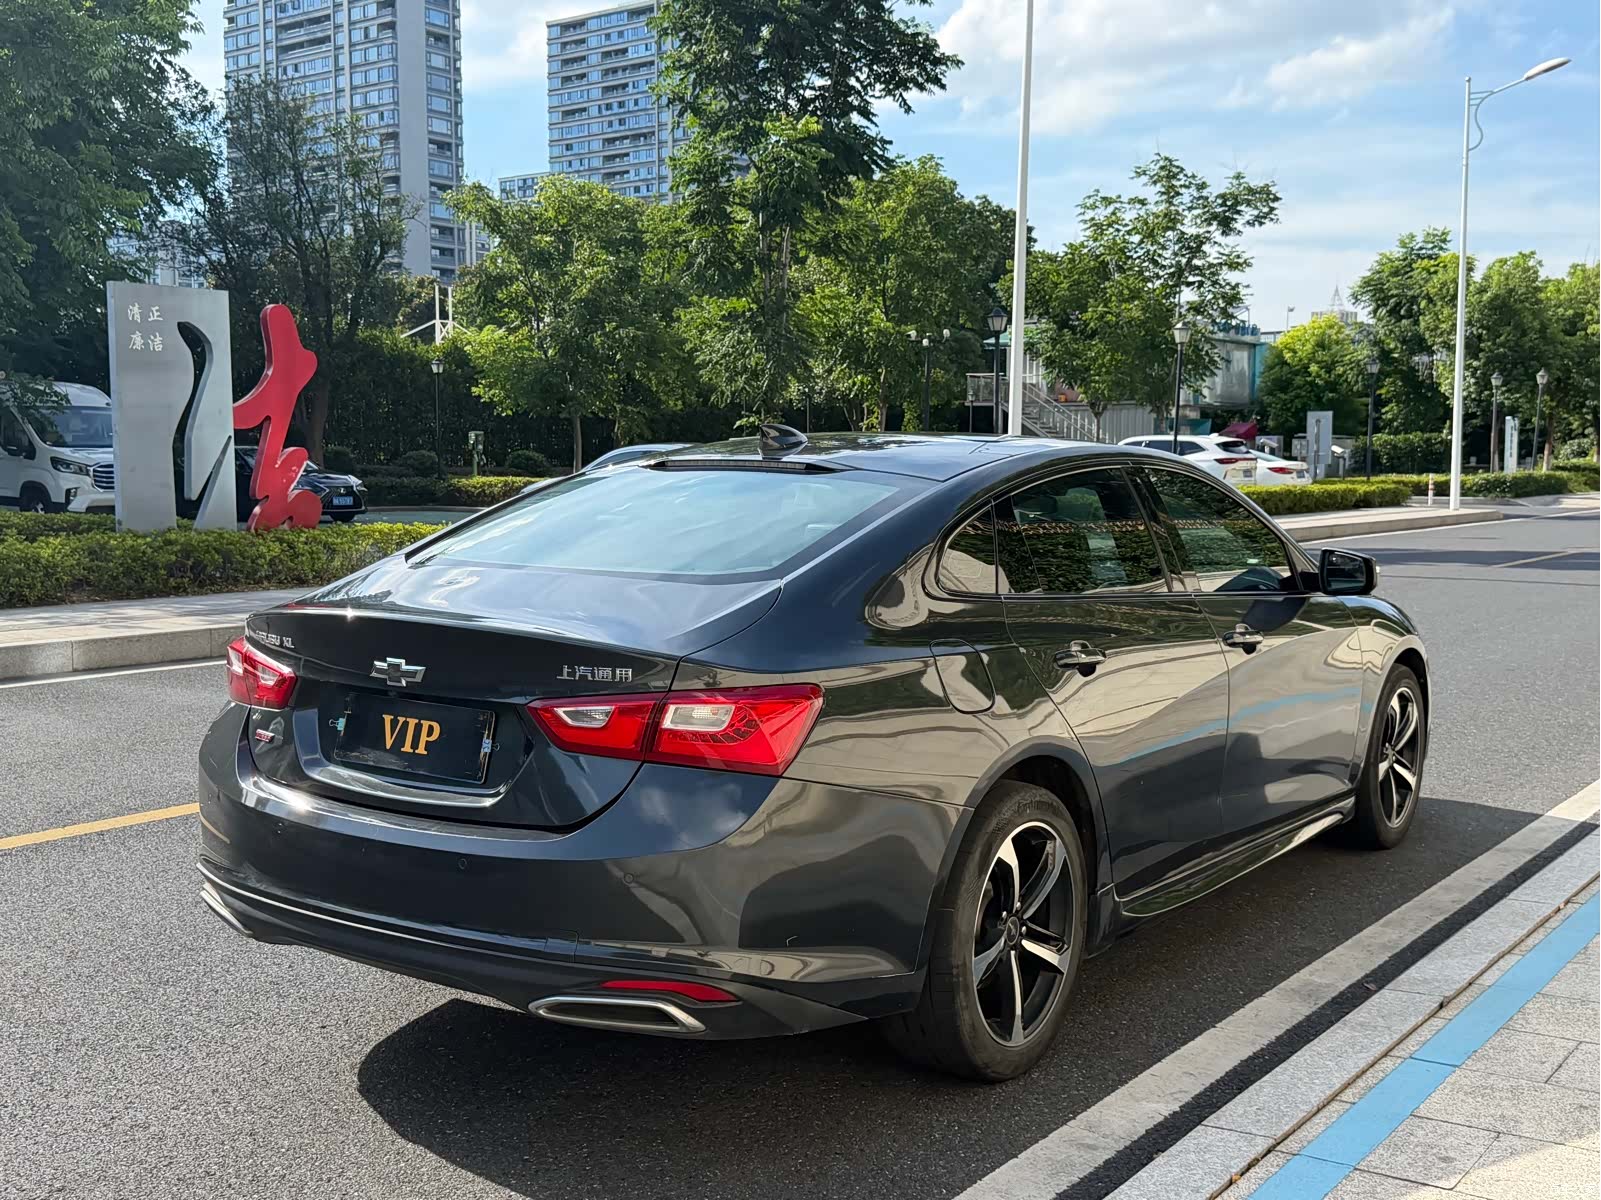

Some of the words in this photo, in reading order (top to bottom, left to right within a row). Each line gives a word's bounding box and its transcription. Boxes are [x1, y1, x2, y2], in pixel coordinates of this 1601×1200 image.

[128, 302, 163, 323] 清正
[129, 330, 163, 351] 廉洁
[282, 636, 295, 648] XL
[556, 665, 633, 682] 上汽通用
[382, 714, 441, 755] VIP
